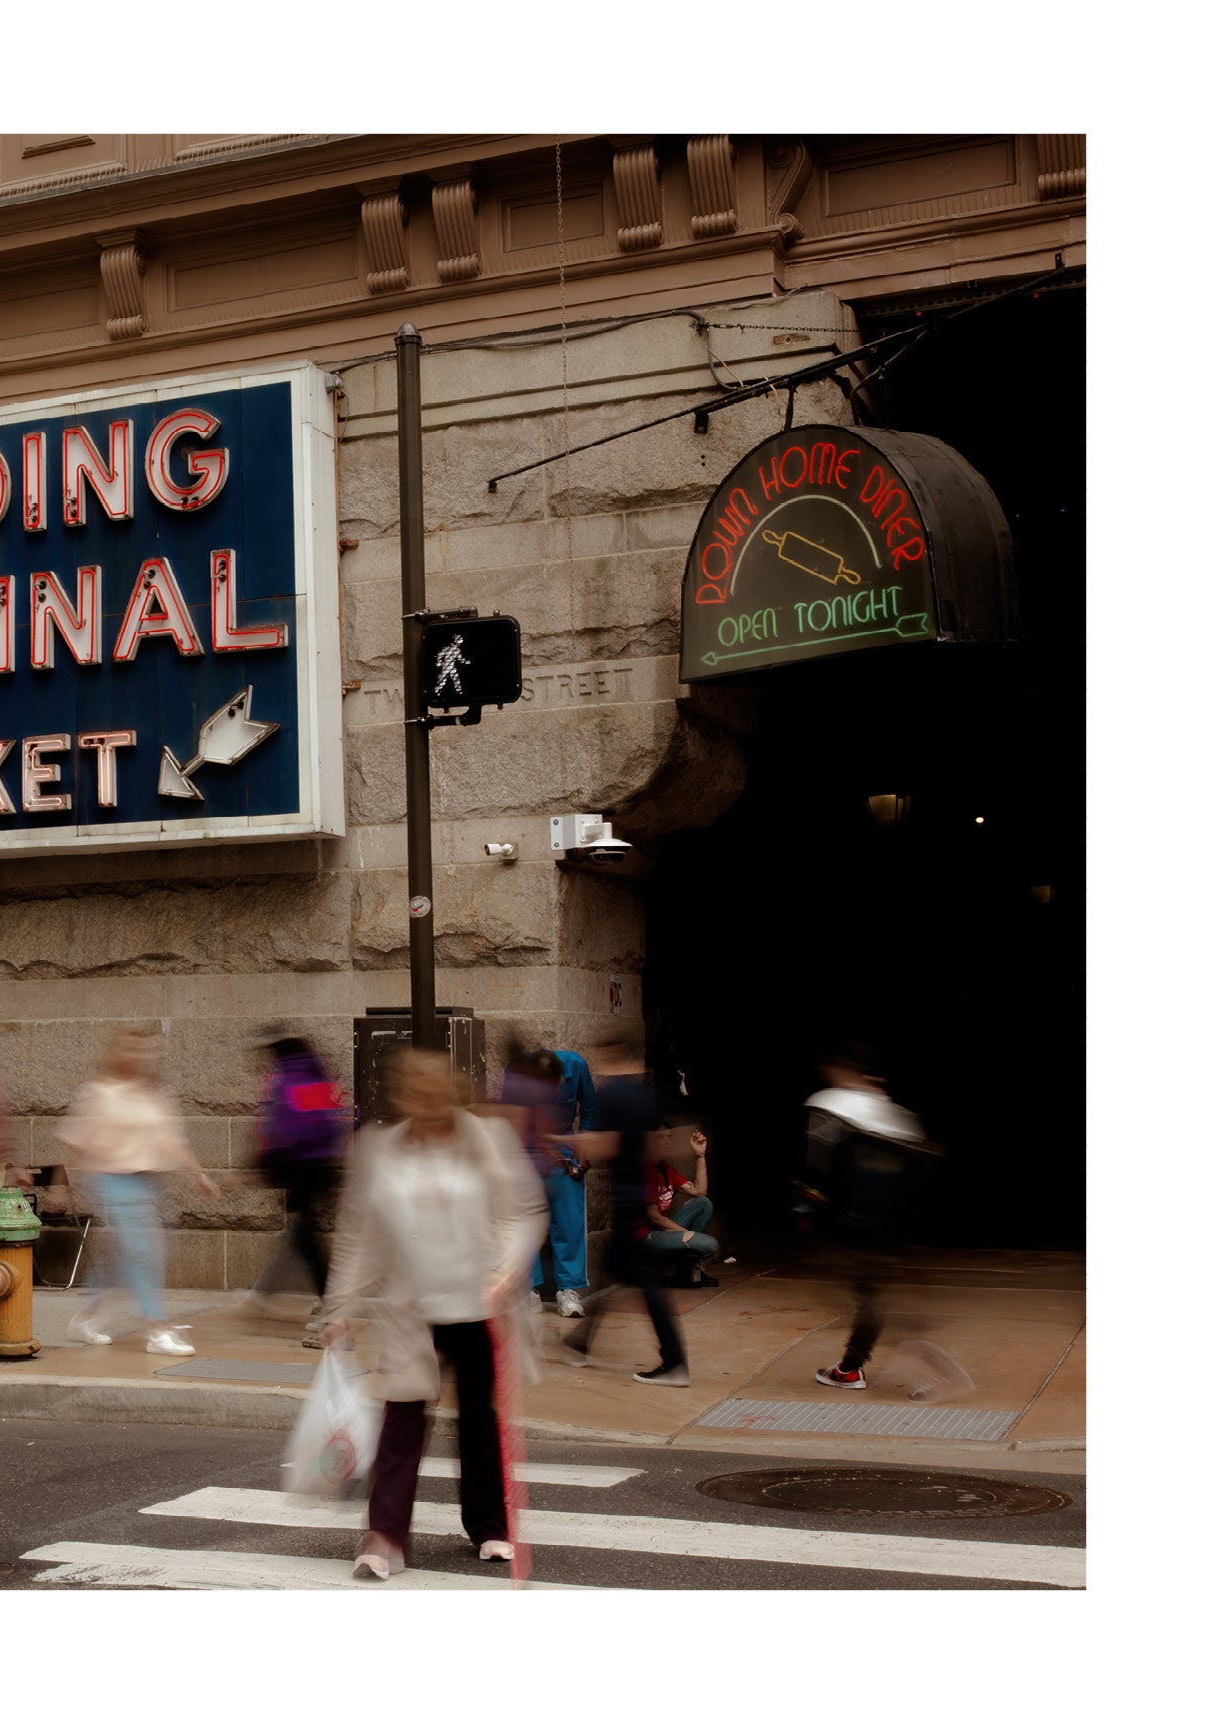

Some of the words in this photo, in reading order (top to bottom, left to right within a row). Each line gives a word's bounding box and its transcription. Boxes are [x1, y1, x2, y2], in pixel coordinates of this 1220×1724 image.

[695, 487, 759, 604] DOWN
[759, 442, 860, 501] HOME
[860, 465, 925, 571] DINER
[718, 607, 779, 647] OPEN
[793, 586, 904, 633] TONIGHT
[521, 668, 634, 701] STREET
